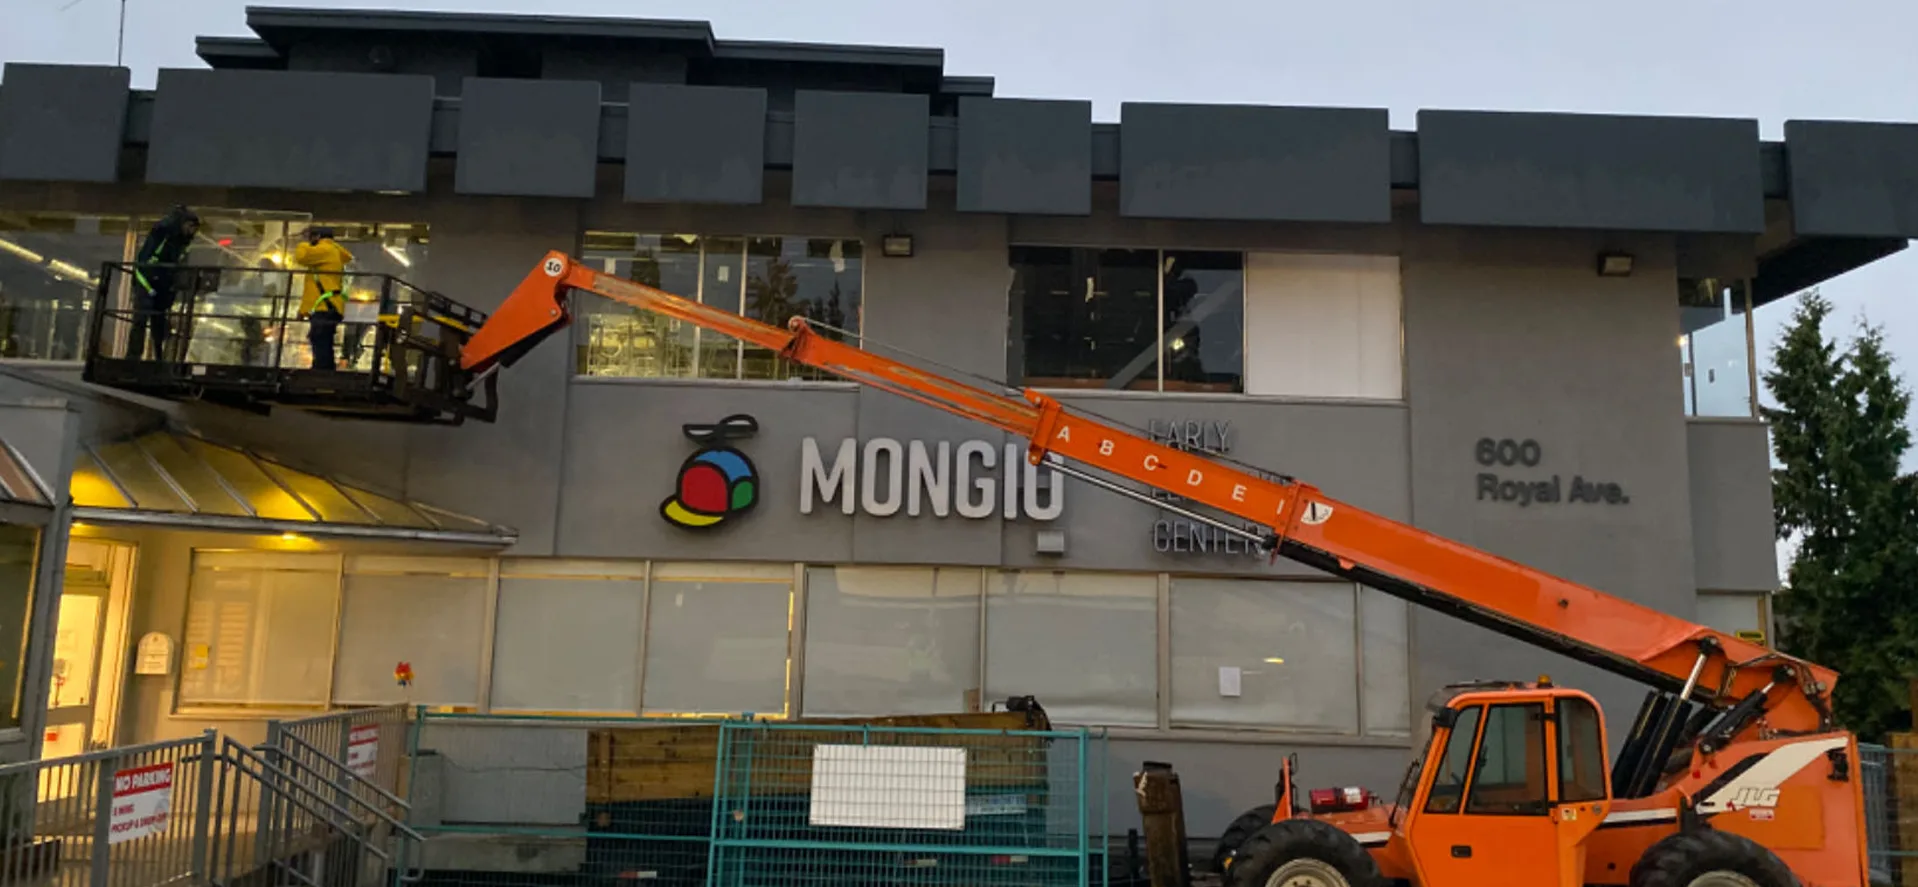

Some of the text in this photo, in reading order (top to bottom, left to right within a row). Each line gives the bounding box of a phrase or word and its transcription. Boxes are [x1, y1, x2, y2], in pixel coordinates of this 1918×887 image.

[1056, 425, 1070, 443] A
[1099, 439, 1114, 456] B
[1144, 455, 1159, 471] C
[1186, 469, 1203, 486] D
[1231, 483, 1248, 502] E
[1476, 437, 1542, 467] 600
[800, 437, 1064, 520] MONGIO
[1477, 473, 1630, 508] Royal Ave.
[115, 768, 171, 792] NO PARKING
[1730, 787, 1780, 806] JLG
